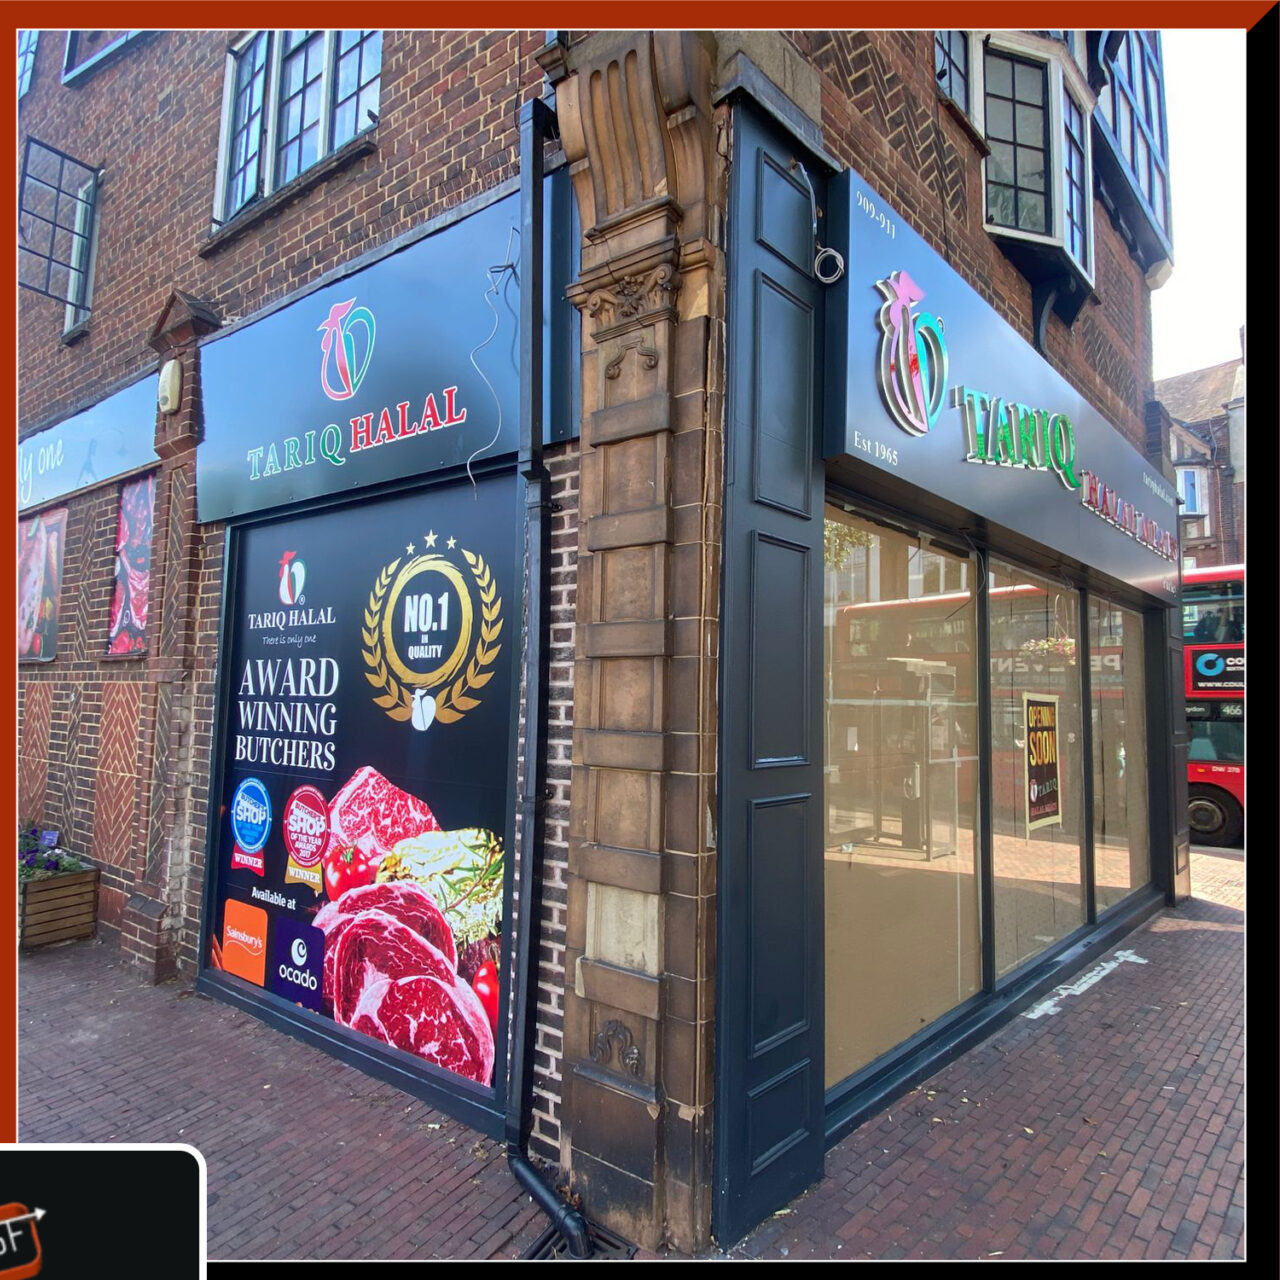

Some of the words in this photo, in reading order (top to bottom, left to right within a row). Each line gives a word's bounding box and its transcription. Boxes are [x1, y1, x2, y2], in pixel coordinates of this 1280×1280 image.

[856, 190, 897, 241] 909-911
[247, 423, 346, 480] TARIQ
[349, 385, 467, 453] HALAL
[950, 385, 1081, 491] TARIQ
[38, 437, 64, 475] one
[854, 430, 872, 453] Est
[874, 439, 898, 467] 1965
[248, 611, 286, 631] TARIQ
[288, 606, 336, 627] HALAL
[404, 591, 449, 633] NO.1
[263, 635, 279, 645] There
[287, 633, 303, 649] only
[304, 633, 317, 644] one
[408, 644, 443, 660] QUALITY
[238, 657, 340, 697] AWARD
[238, 700, 338, 736] WINNING
[1222, 705, 1242, 716] 466
[235, 735, 336, 772] BUTCHERS
[1029, 731, 1056, 766] SOON
[236, 804, 266, 825] SHOP
[288, 814, 326, 836] SHOP
[234, 852, 263, 869] WINNER
[288, 866, 320, 883] WINNER
[251, 886, 286, 907] Available
[287, 898, 297, 910] at
[226, 925, 262, 949] Sainsbury's
[279, 964, 317, 991] ocado
